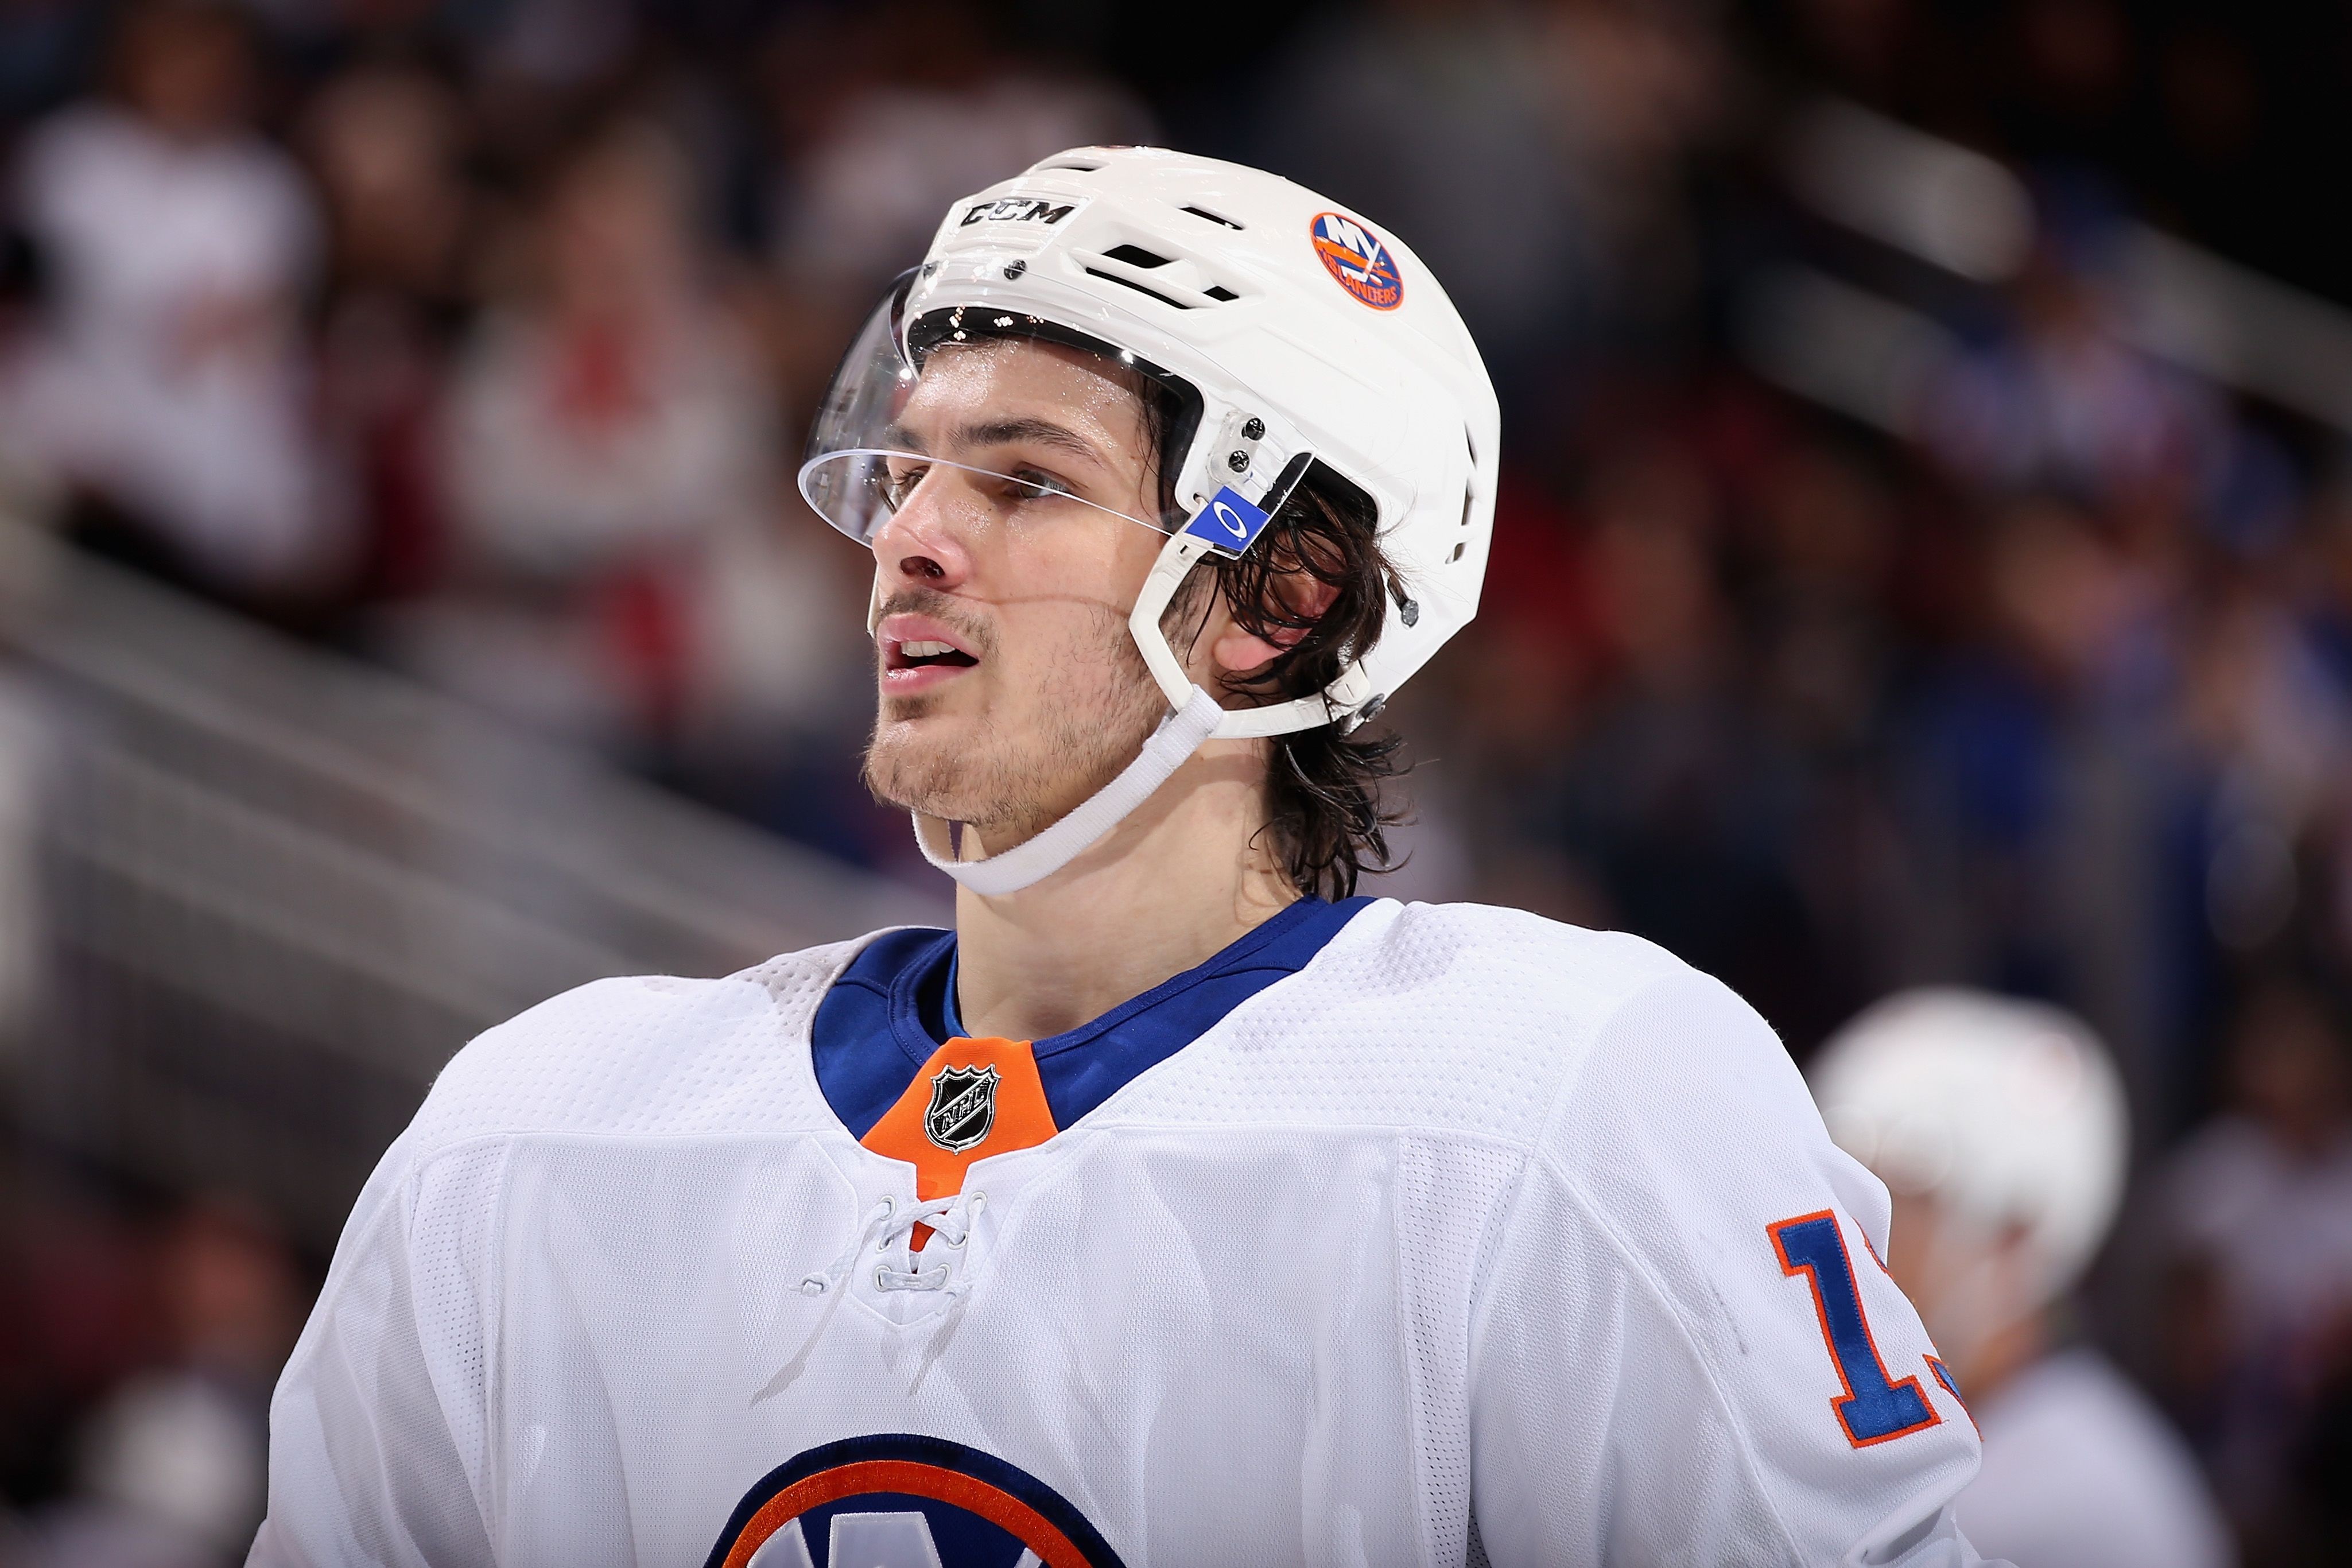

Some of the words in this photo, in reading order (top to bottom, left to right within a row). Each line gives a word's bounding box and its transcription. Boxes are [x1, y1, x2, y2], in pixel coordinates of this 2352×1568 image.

[960, 200, 1075, 227] CCM
[1318, 248, 1397, 304] ISLANDERS
[941, 1086, 985, 1133] NHL
[1765, 1208, 1984, 1450] 1
